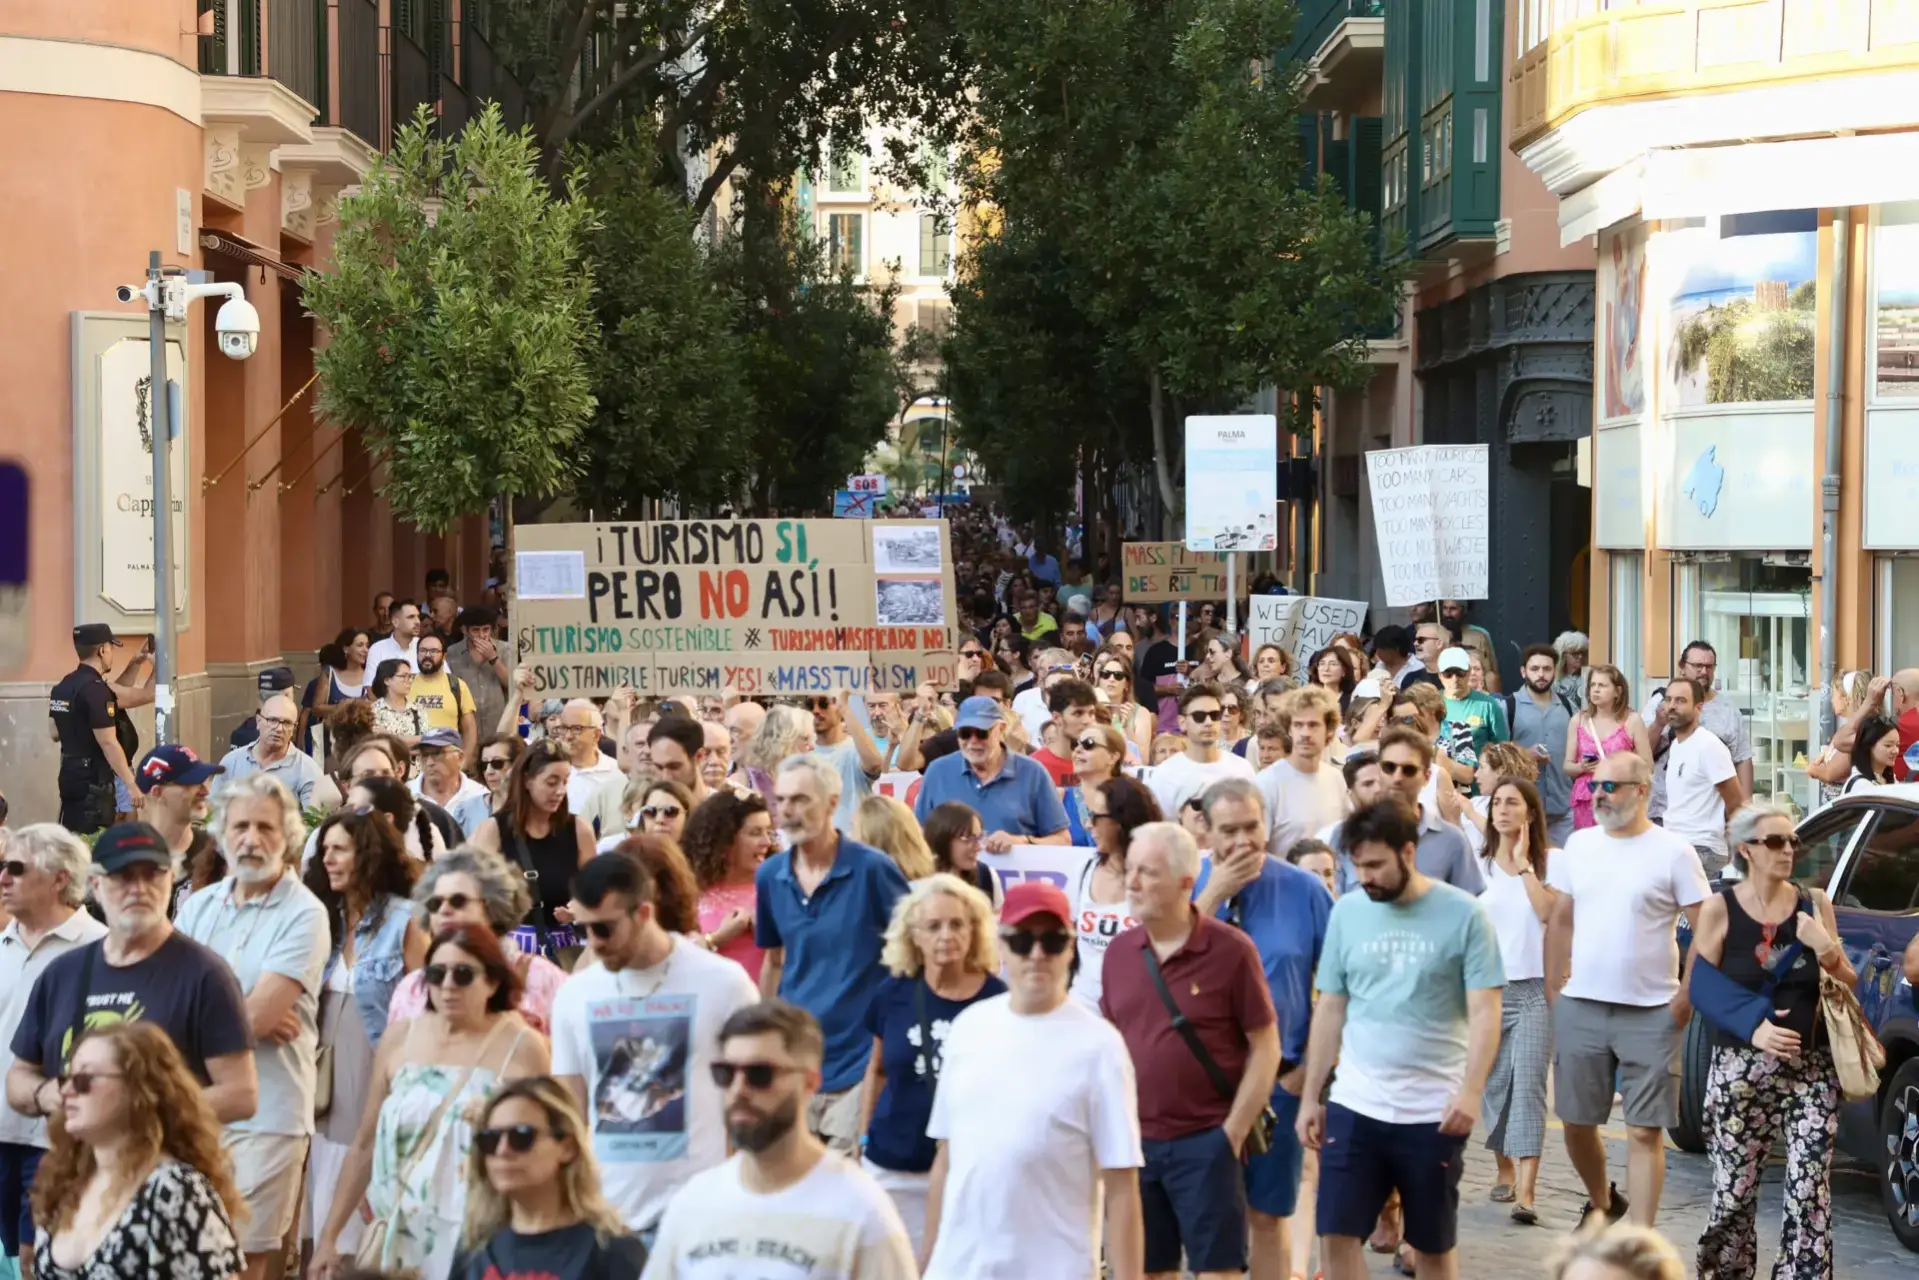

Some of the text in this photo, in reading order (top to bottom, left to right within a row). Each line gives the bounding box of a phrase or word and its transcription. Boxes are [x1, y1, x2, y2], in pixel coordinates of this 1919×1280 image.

[1217, 430, 1246, 439] PALMA
[1376, 468, 1477, 489] TOO MANY CARS
[1379, 496, 1405, 514] TOO
[1407, 491, 1440, 509] MANY
[127, 563, 150, 571] PALMA
[588, 570, 683, 623] PERO
[699, 569, 749, 619] NO
[1257, 602, 1358, 628] WE USED
[1258, 626, 1286, 644] TO
[724, 665, 762, 693] YES!
